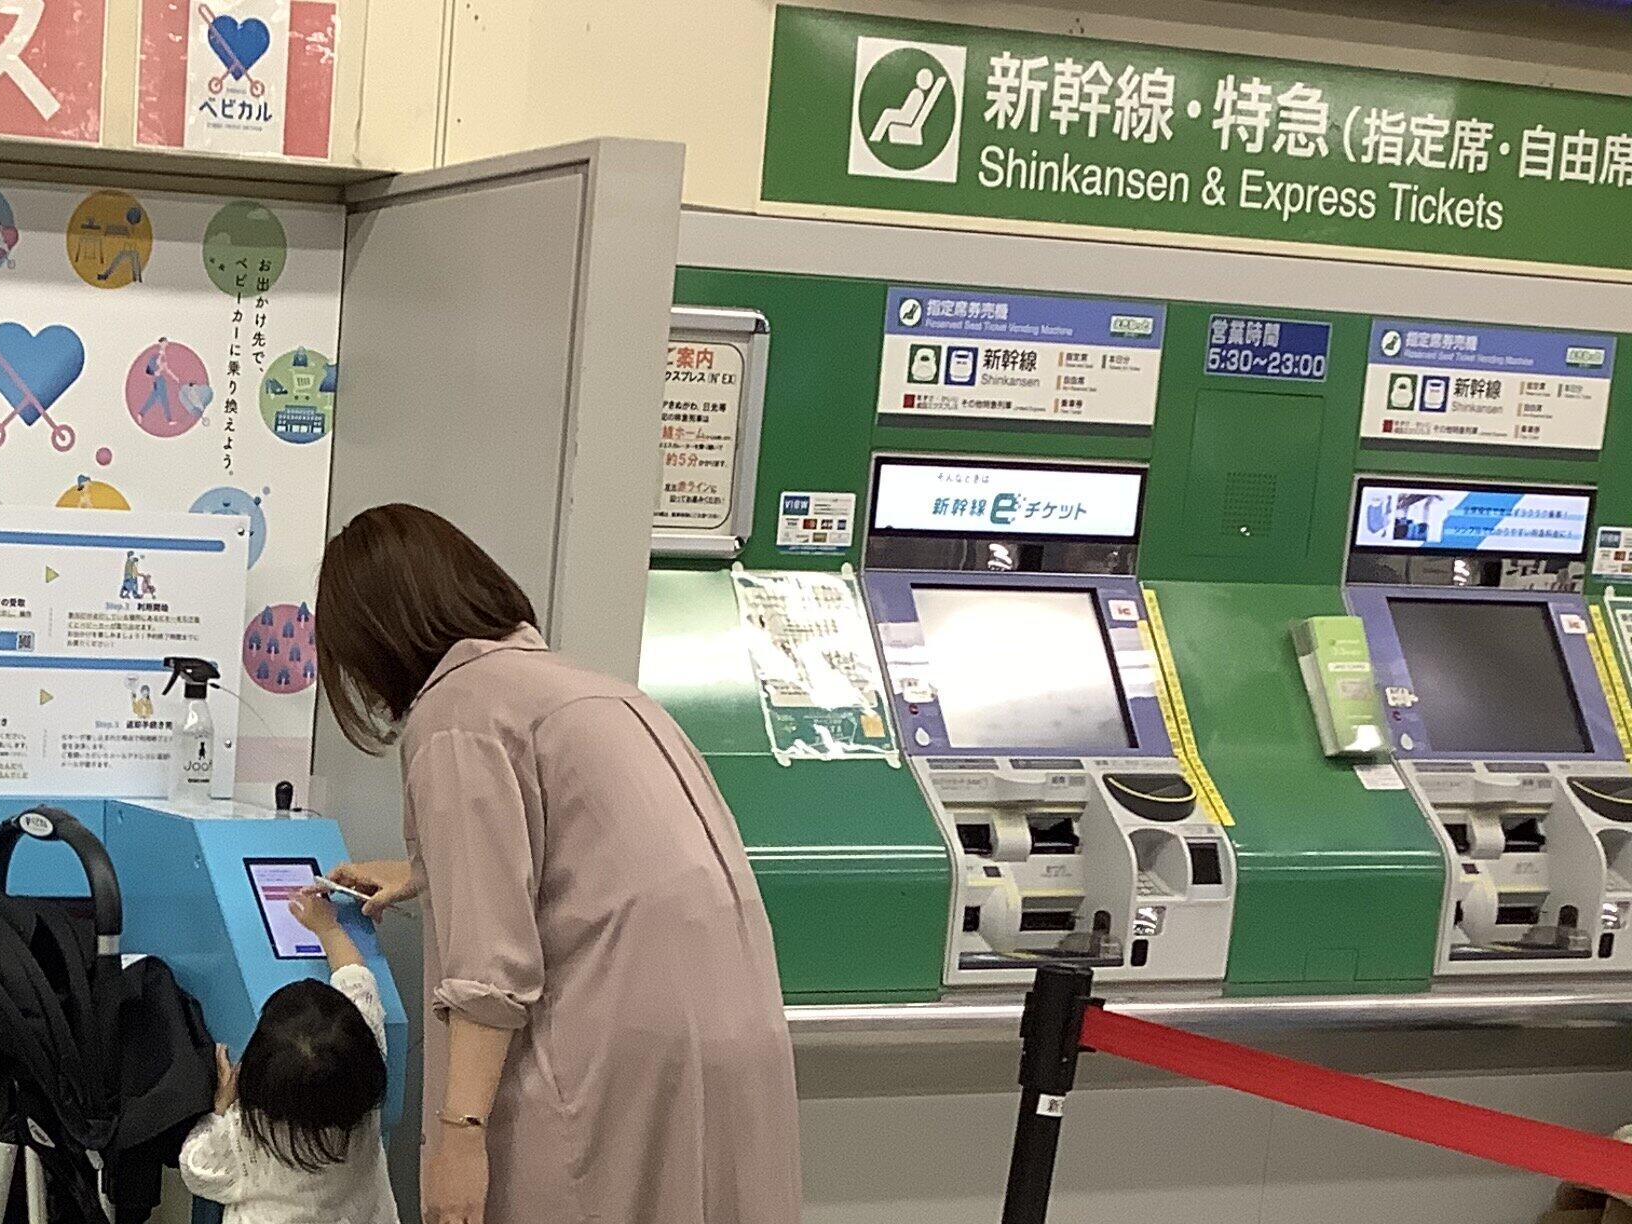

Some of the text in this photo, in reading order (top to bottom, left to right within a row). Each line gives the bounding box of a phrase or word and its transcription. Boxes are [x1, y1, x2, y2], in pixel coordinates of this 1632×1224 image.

[199, 97, 273, 122] ベビカル
[978, 145, 1504, 231] Shinkansen & Express Tickets
[252, 259, 272, 373] お出かけ先で、
[1211, 318, 1280, 348] 営業時間
[223, 258, 249, 476] ベビーカーに乗り換えよう。
[982, 348, 1038, 372] 新幹線
[980, 372, 1041, 388] Shinkansen
[1453, 377, 1502, 400] 新幹線
